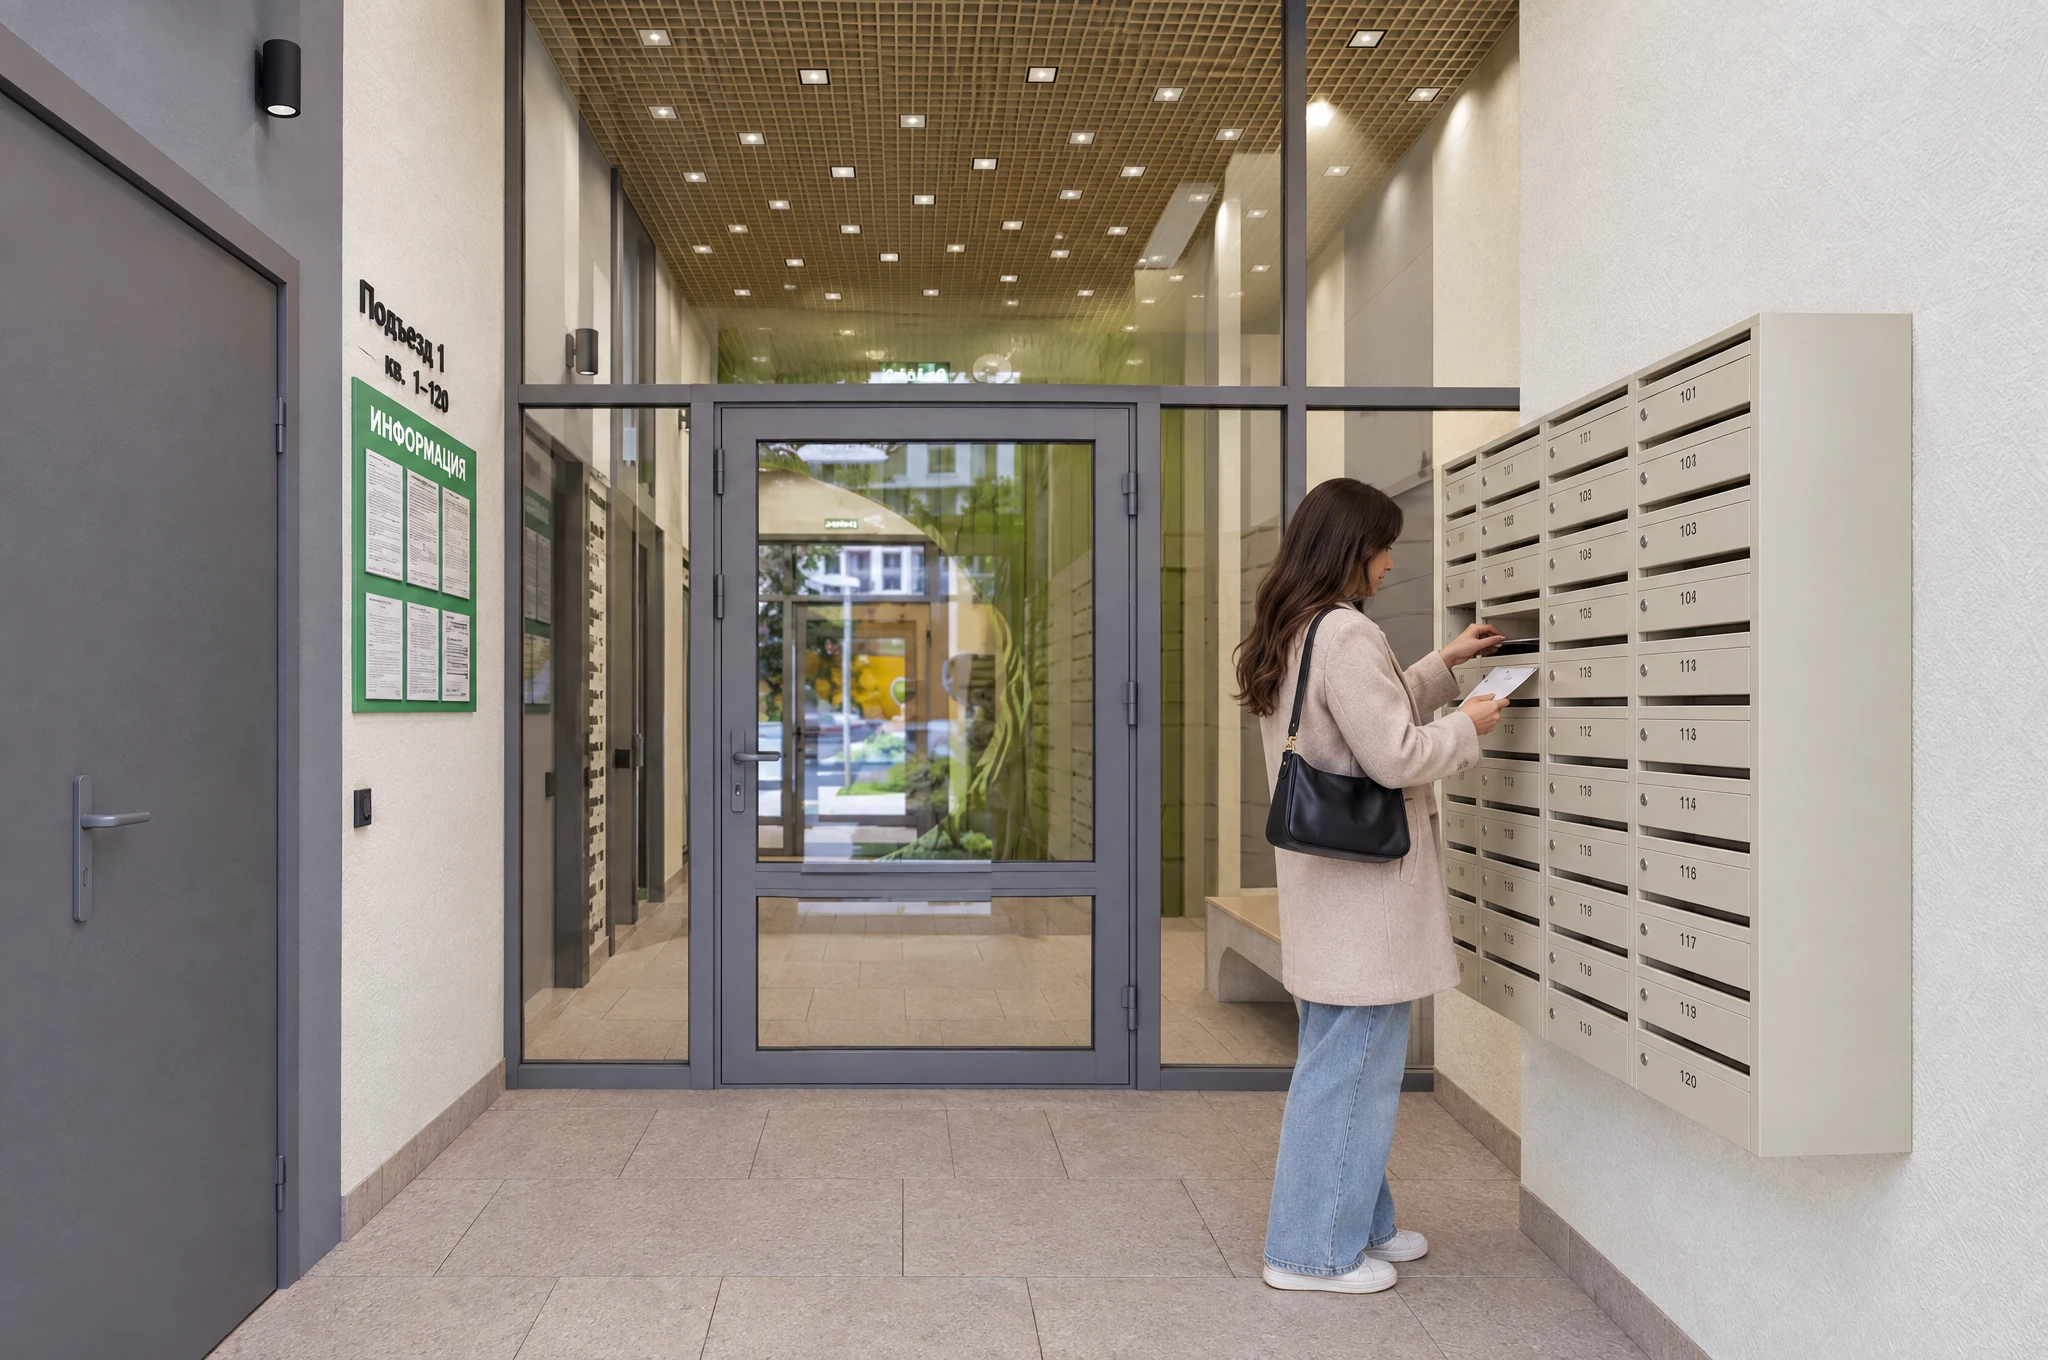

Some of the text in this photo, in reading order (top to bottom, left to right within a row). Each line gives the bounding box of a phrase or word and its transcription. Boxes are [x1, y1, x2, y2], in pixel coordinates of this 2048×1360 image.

[359, 278, 445, 373] Подъезд 1
[384, 354, 406, 386] кв.
[1679, 385, 1695, 402] 101
[370, 404, 466, 482] ИНФОРМАЦИЯ
[1579, 430, 1592, 444] 101
[1679, 521, 1696, 537] 103
[1579, 725, 1592, 737] 112
[1679, 932, 1696, 949] 117
[1679, 1069, 1696, 1088] 120
